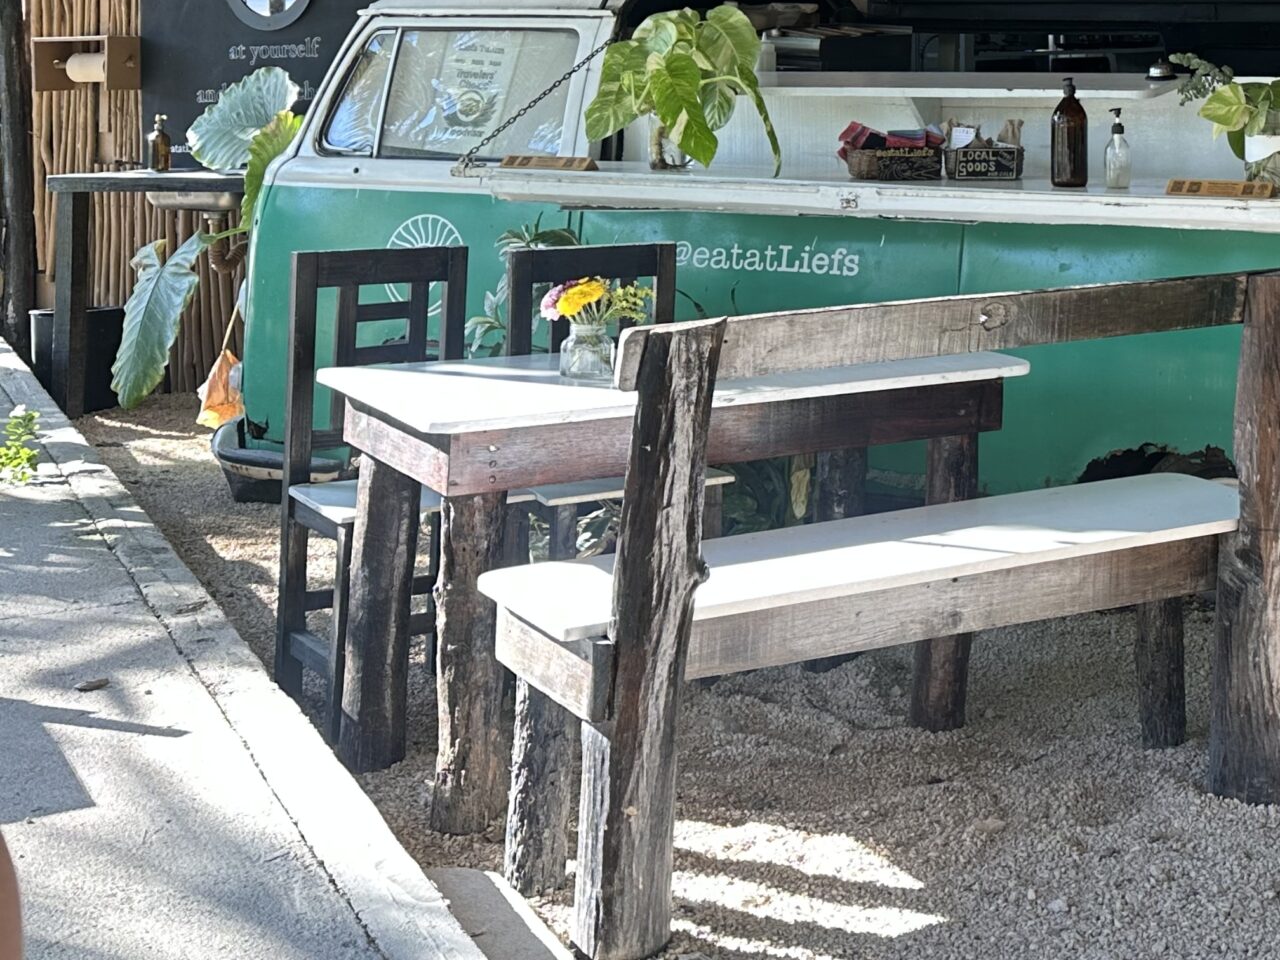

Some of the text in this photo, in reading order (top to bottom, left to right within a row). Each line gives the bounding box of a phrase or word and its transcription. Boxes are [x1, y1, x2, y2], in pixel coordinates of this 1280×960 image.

[229, 37, 322, 66] at yourself
[959, 150, 997, 161] LOCAL
[958, 162, 996, 176] GOODS
[676, 240, 860, 277] @eatatLiefs
